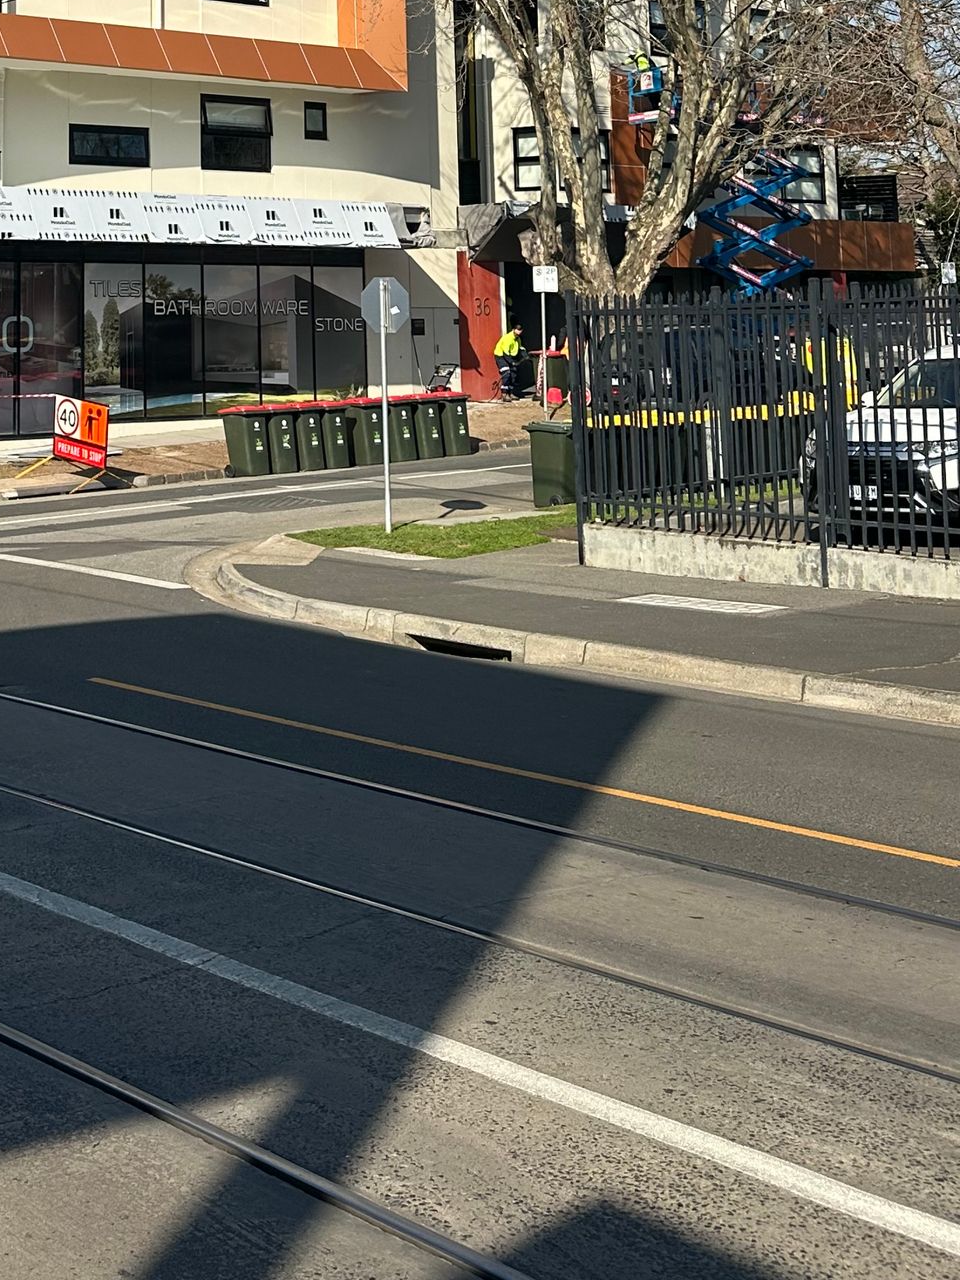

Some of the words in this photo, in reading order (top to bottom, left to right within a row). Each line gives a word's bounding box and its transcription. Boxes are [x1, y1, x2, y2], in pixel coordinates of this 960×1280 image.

[90, 280, 142, 298] TILES
[474, 297, 491, 316] 36
[315, 317, 364, 332] STONE
[60, 409, 76, 427] 40
[57, 442, 81, 457] PREPARE
[81, 448, 89, 459] TO
[89, 451, 104, 463] STOP
